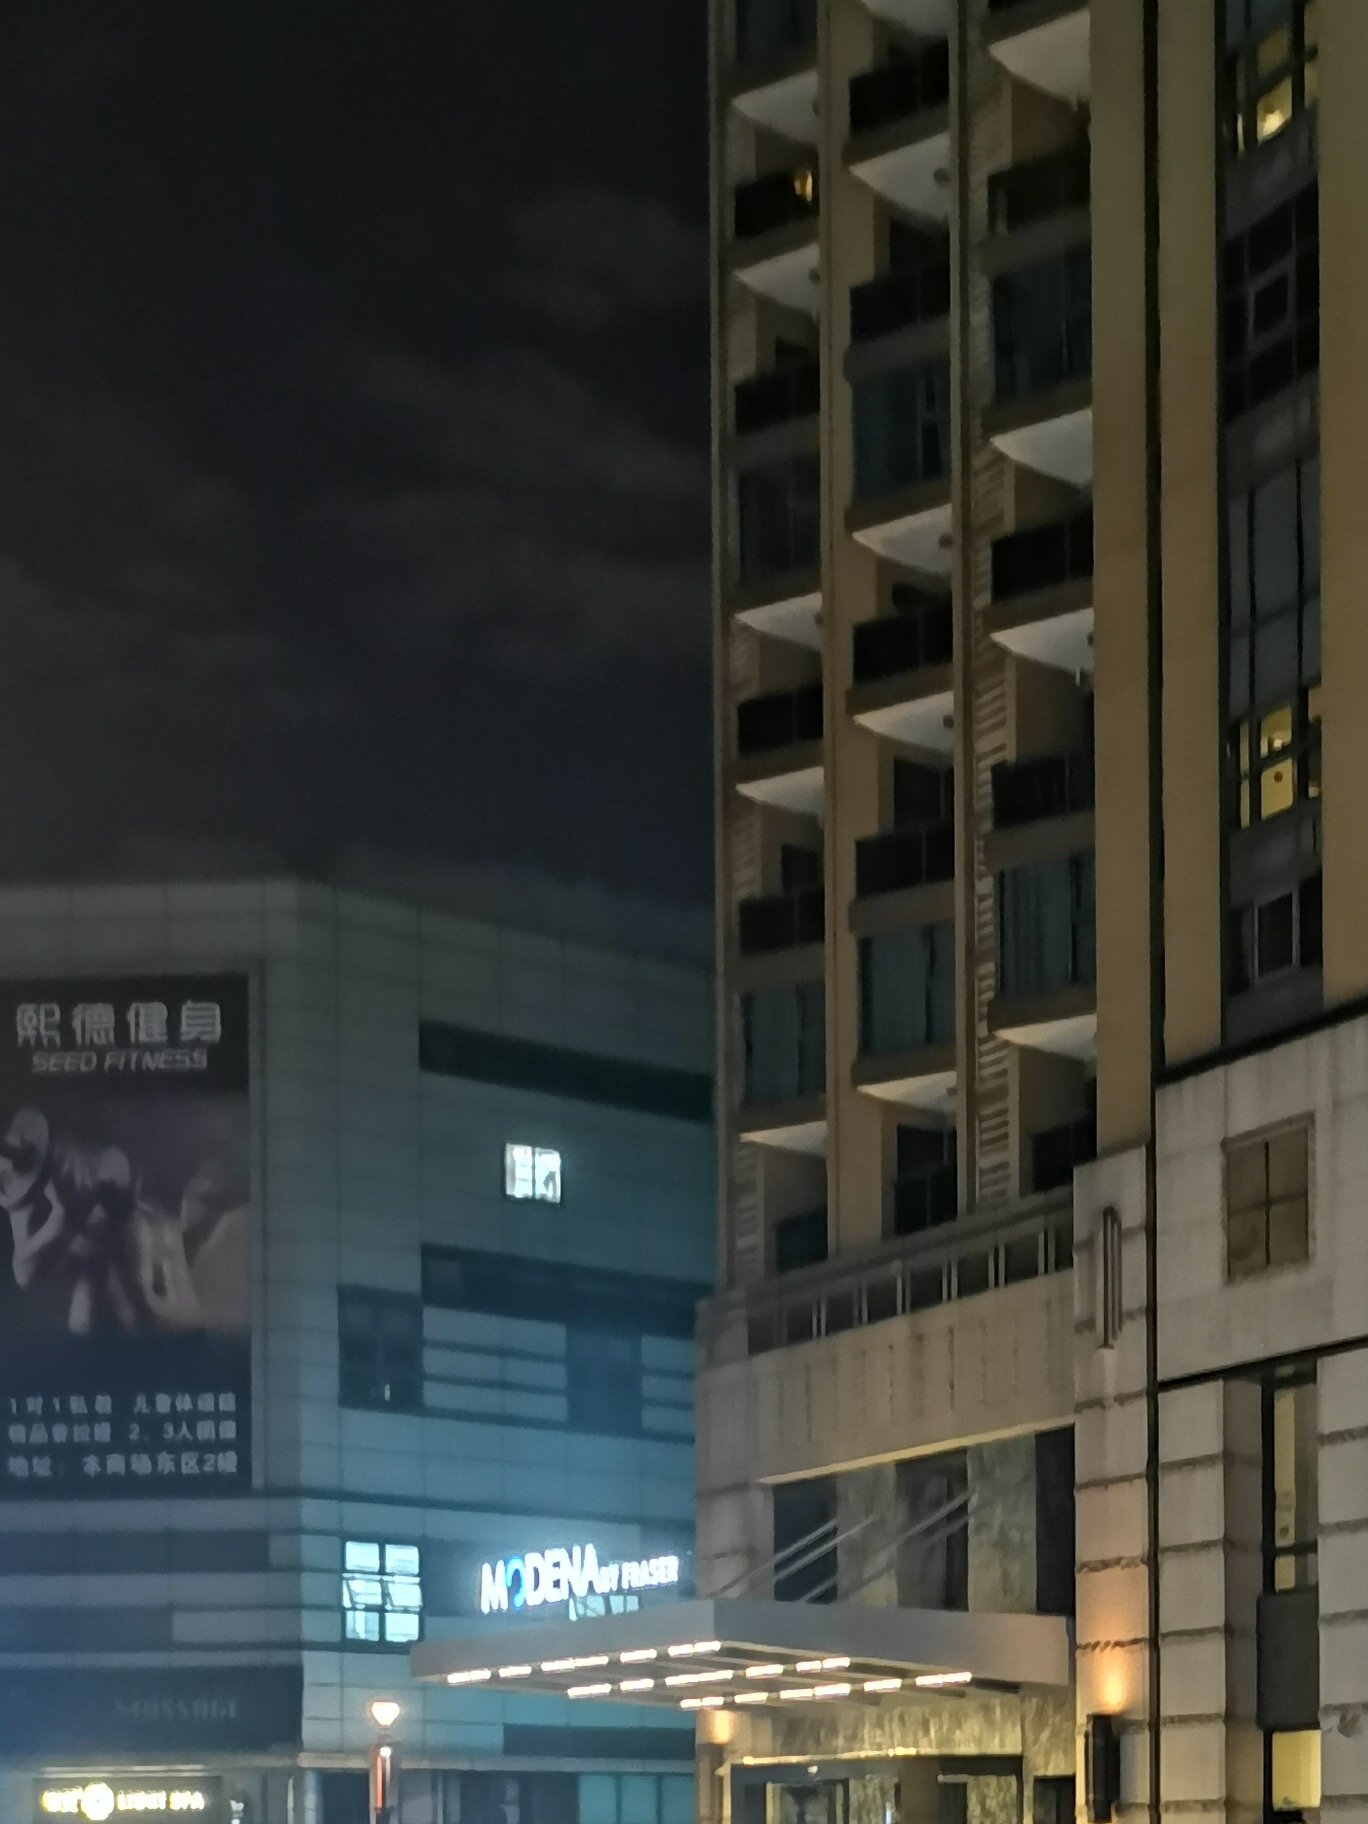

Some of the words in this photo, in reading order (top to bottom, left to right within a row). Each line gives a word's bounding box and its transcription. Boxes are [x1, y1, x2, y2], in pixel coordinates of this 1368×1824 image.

[481, 1543, 601, 1614] MODENA
[622, 1556, 678, 1589] FRASER
[170, 1790, 205, 1810] SPA
